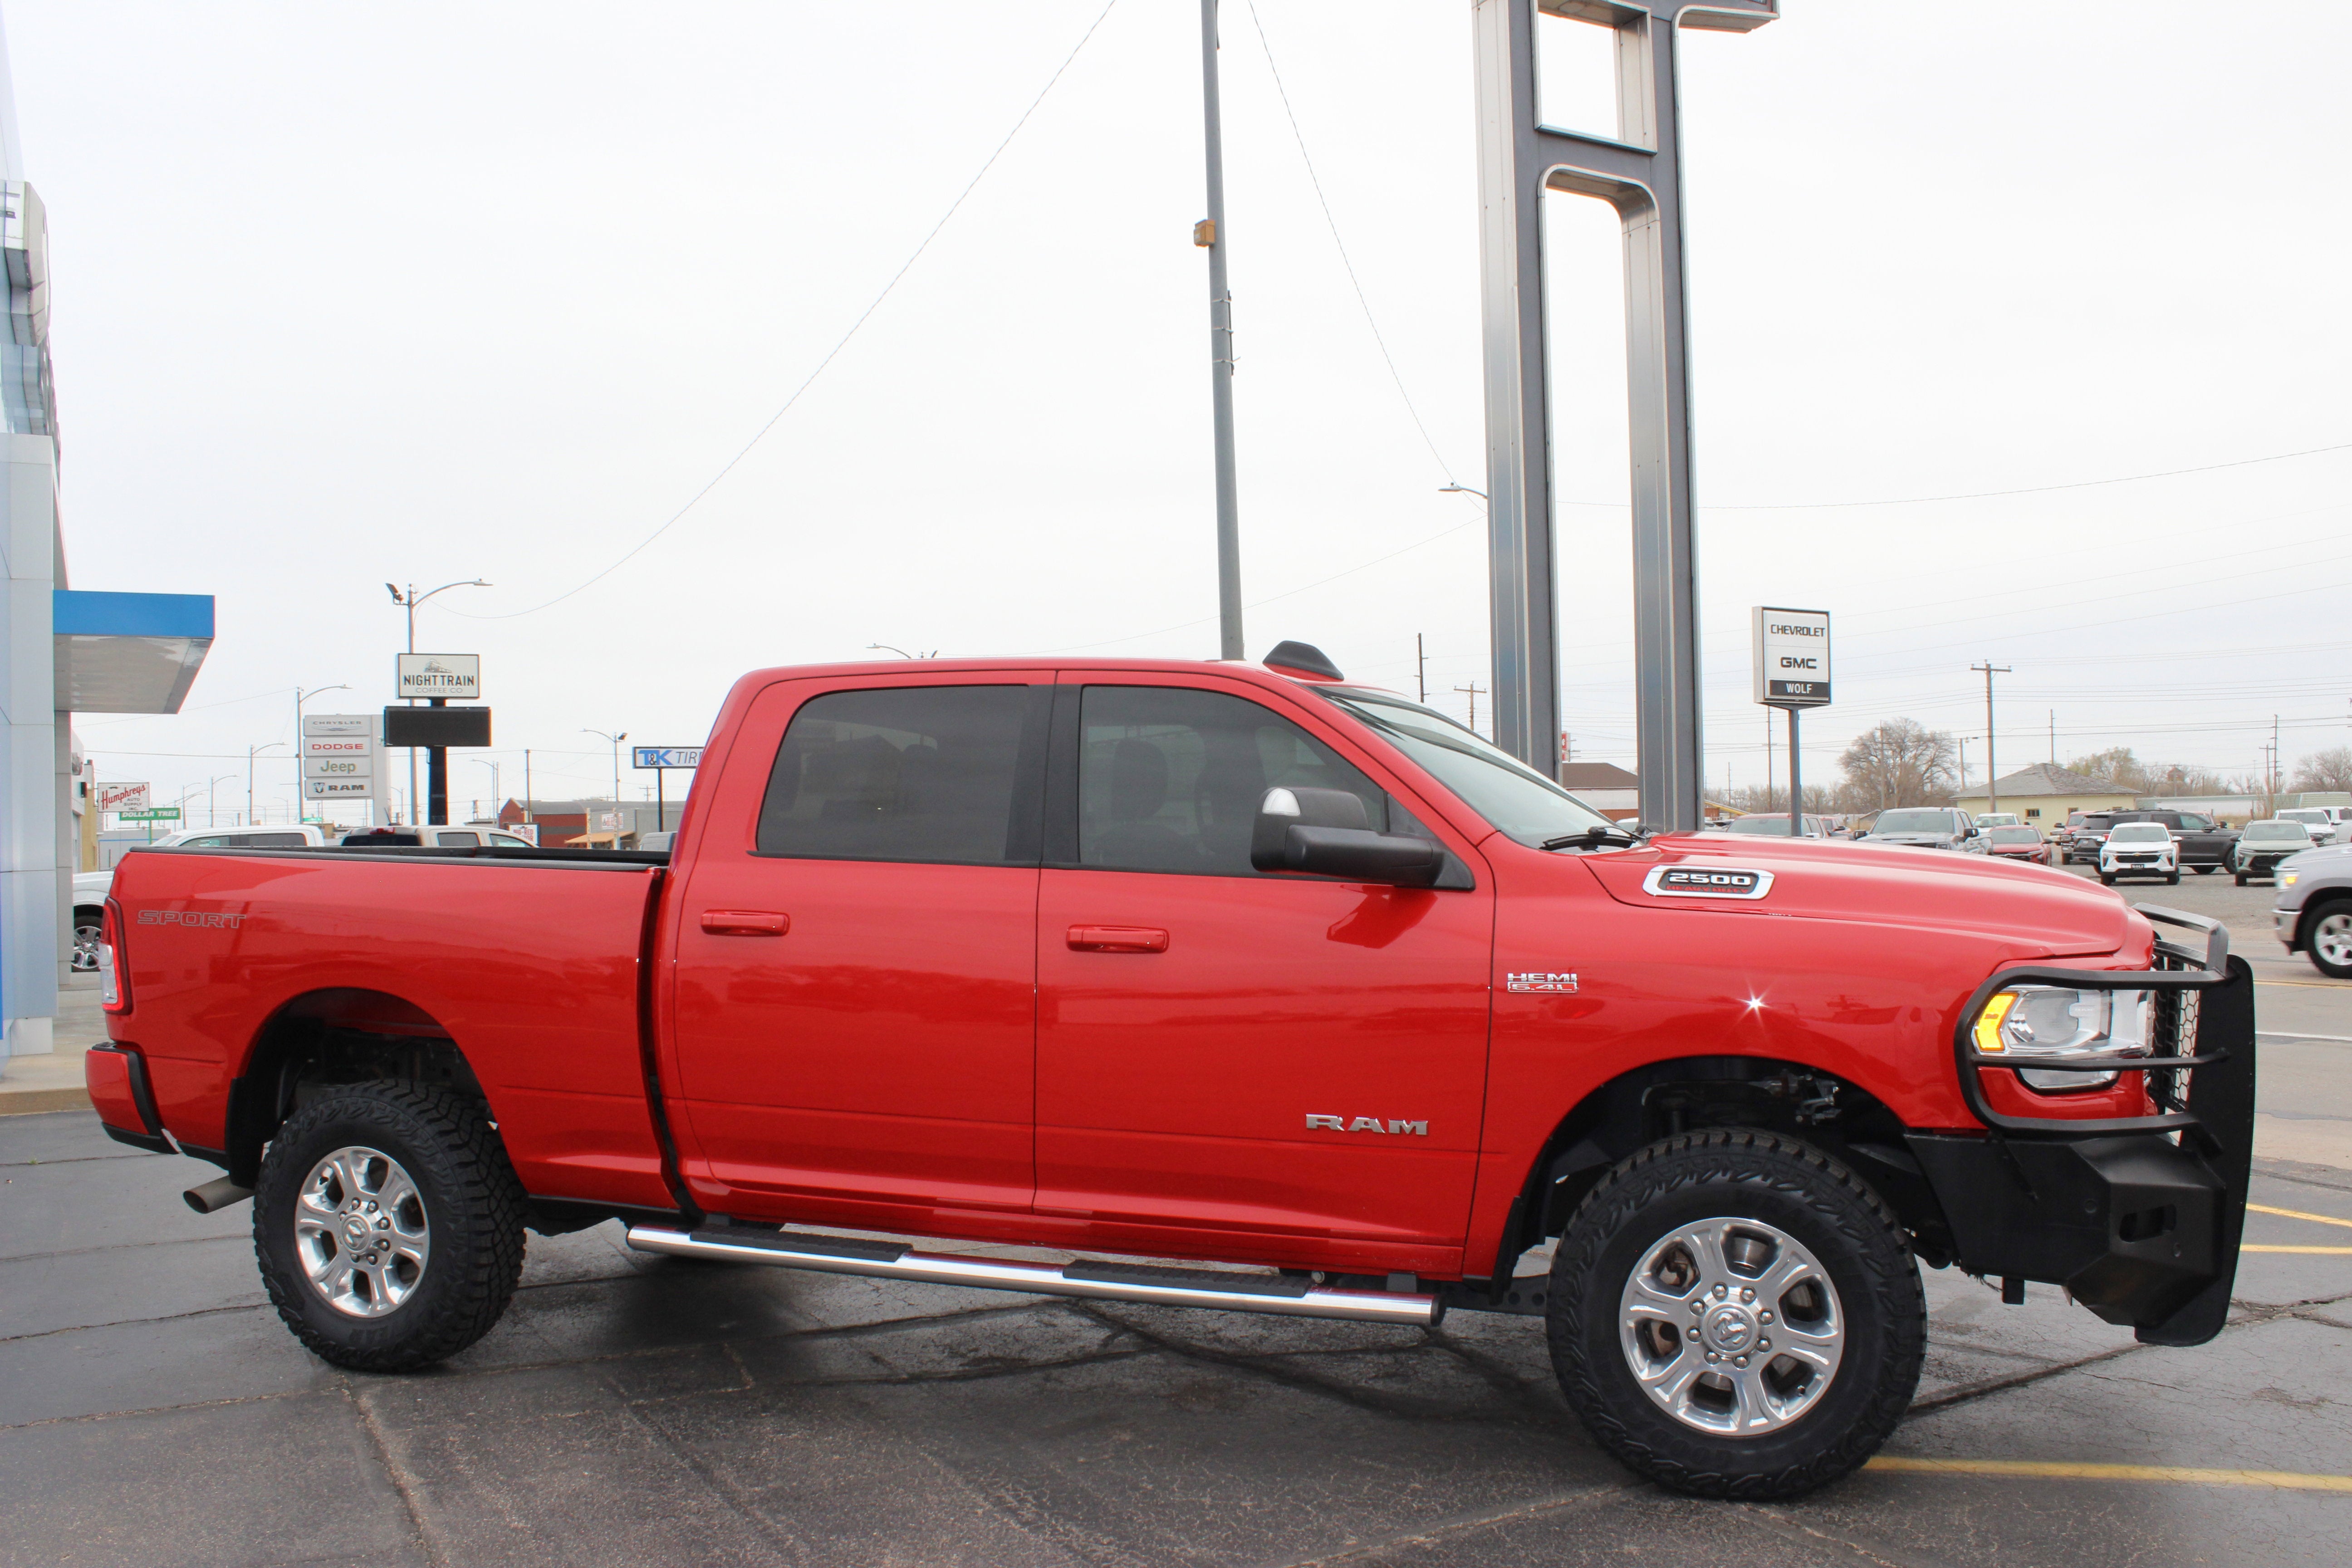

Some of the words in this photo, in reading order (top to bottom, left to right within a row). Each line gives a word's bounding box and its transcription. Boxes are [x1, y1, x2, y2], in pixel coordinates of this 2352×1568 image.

[1770, 624, 1825, 637] CHEVROLET
[1780, 657, 1817, 669] GMC
[404, 675, 438, 686] NIGHT
[440, 675, 475, 686] TRAIN
[1786, 683, 1812, 694] WOLF
[637, 750, 674, 765] T&K
[320, 760, 357, 774] Jeep
[102, 784, 146, 810] Humphreys
[1669, 873, 1751, 885] 2500
[137, 910, 247, 928] SPORT
[1507, 973, 1577, 982] HEMI
[1306, 1114, 1428, 1135] RAM
